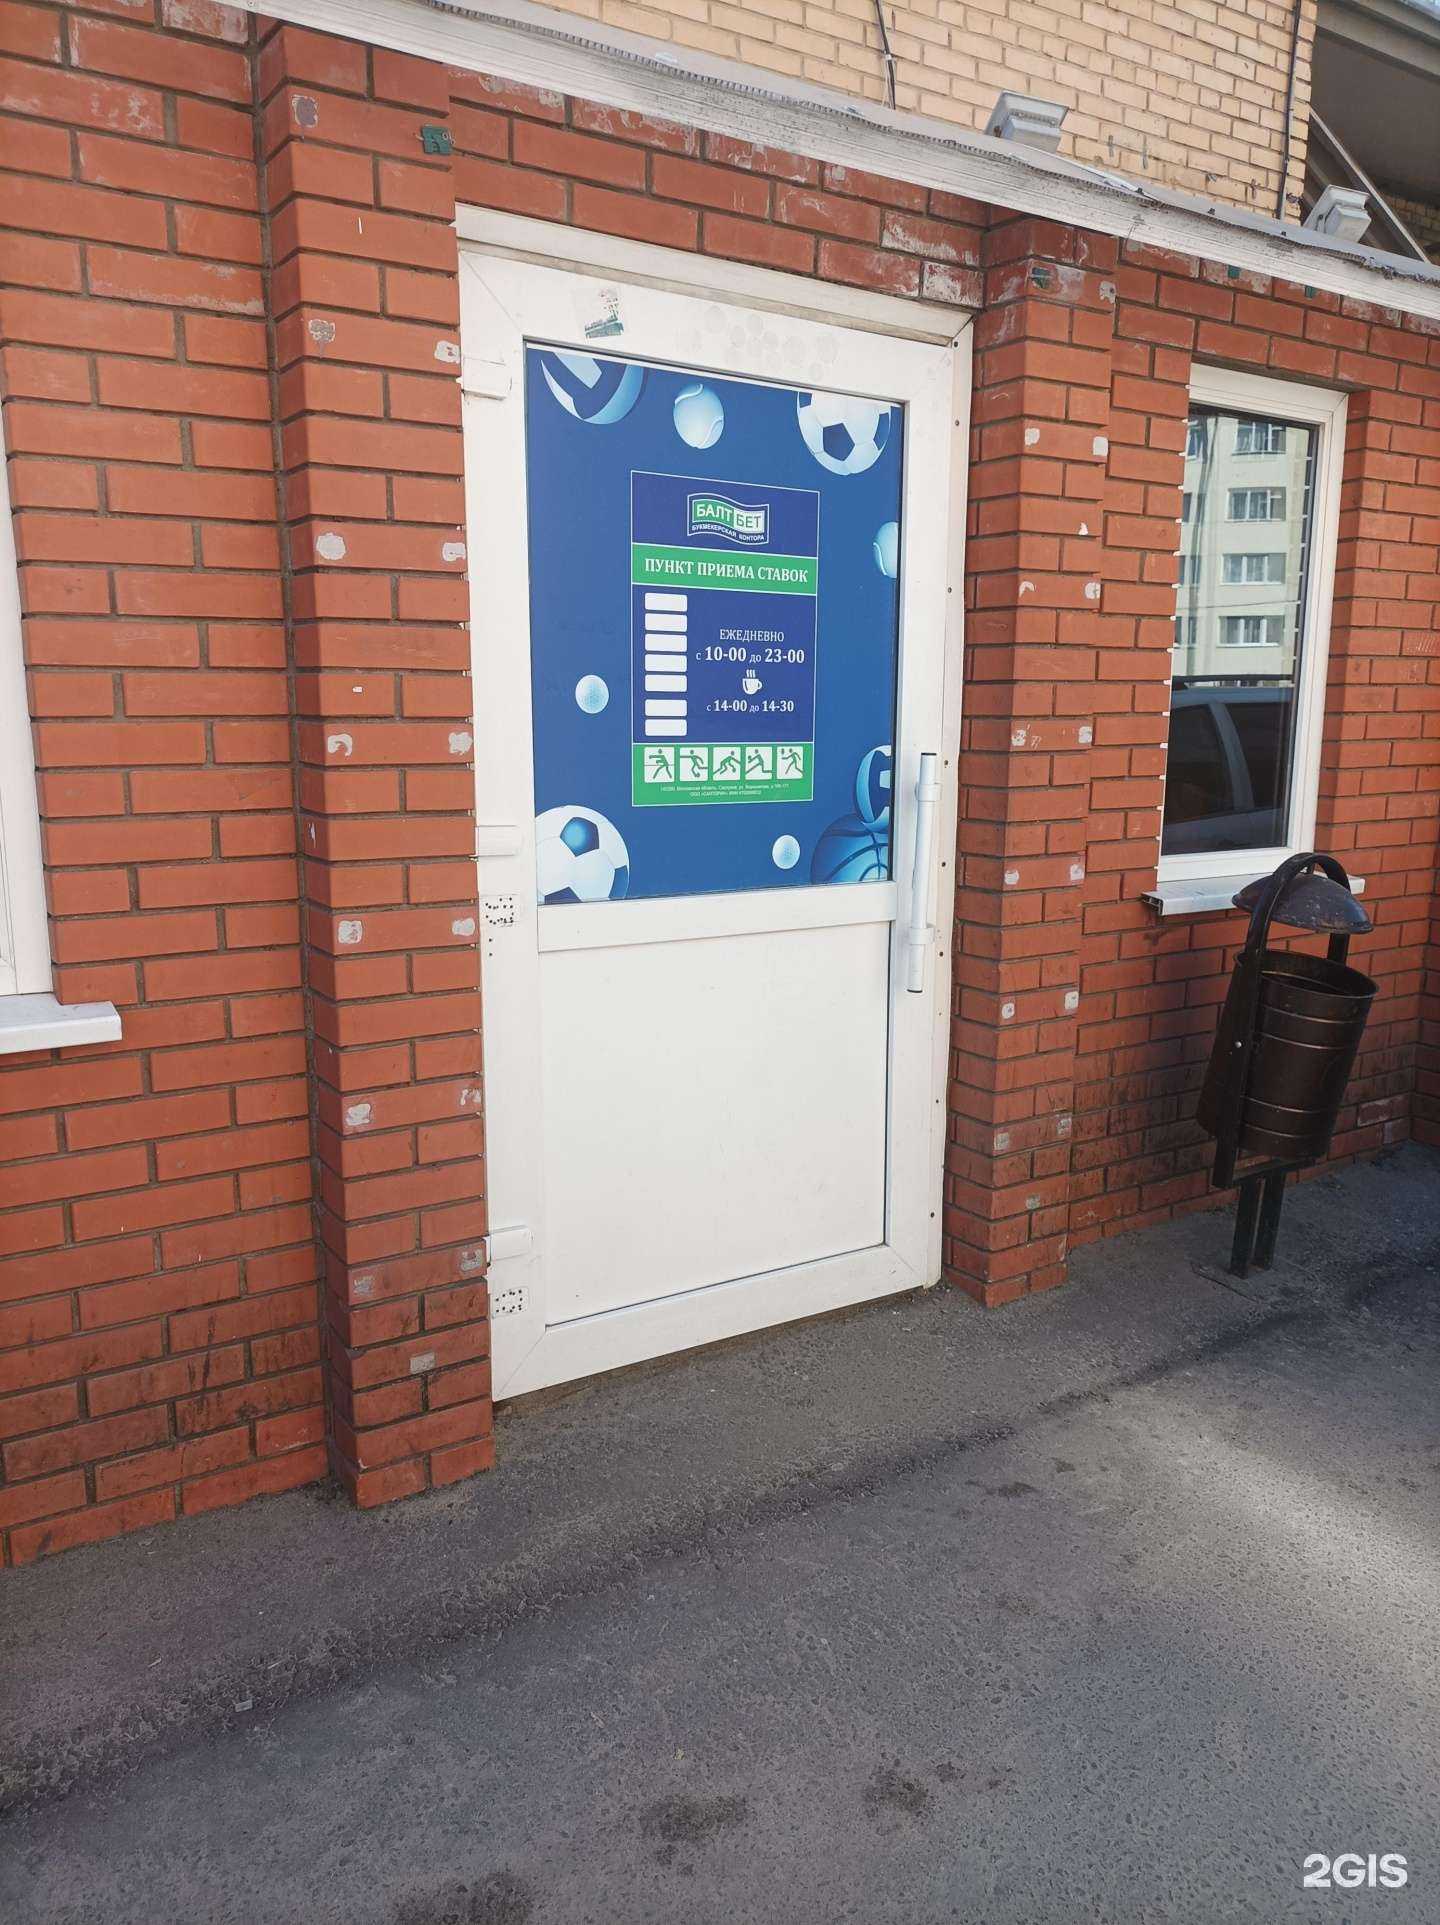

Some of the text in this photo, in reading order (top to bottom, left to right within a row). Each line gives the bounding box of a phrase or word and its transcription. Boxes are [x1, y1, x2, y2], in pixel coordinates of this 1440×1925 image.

[696, 503, 762, 528] БАЛТ БЕТ
[691, 523, 765, 542] БУКМЕКЕРСКАЯ КОНТОРА
[644, 558, 808, 583] ПУНКТ ПРИЕМА СТАВОК
[719, 628, 785, 642] ЕЖЕДНЕВНО
[696, 646, 805, 663] с 10-00 до 23-00
[706, 699, 795, 713] с 14-00 до 14-30
